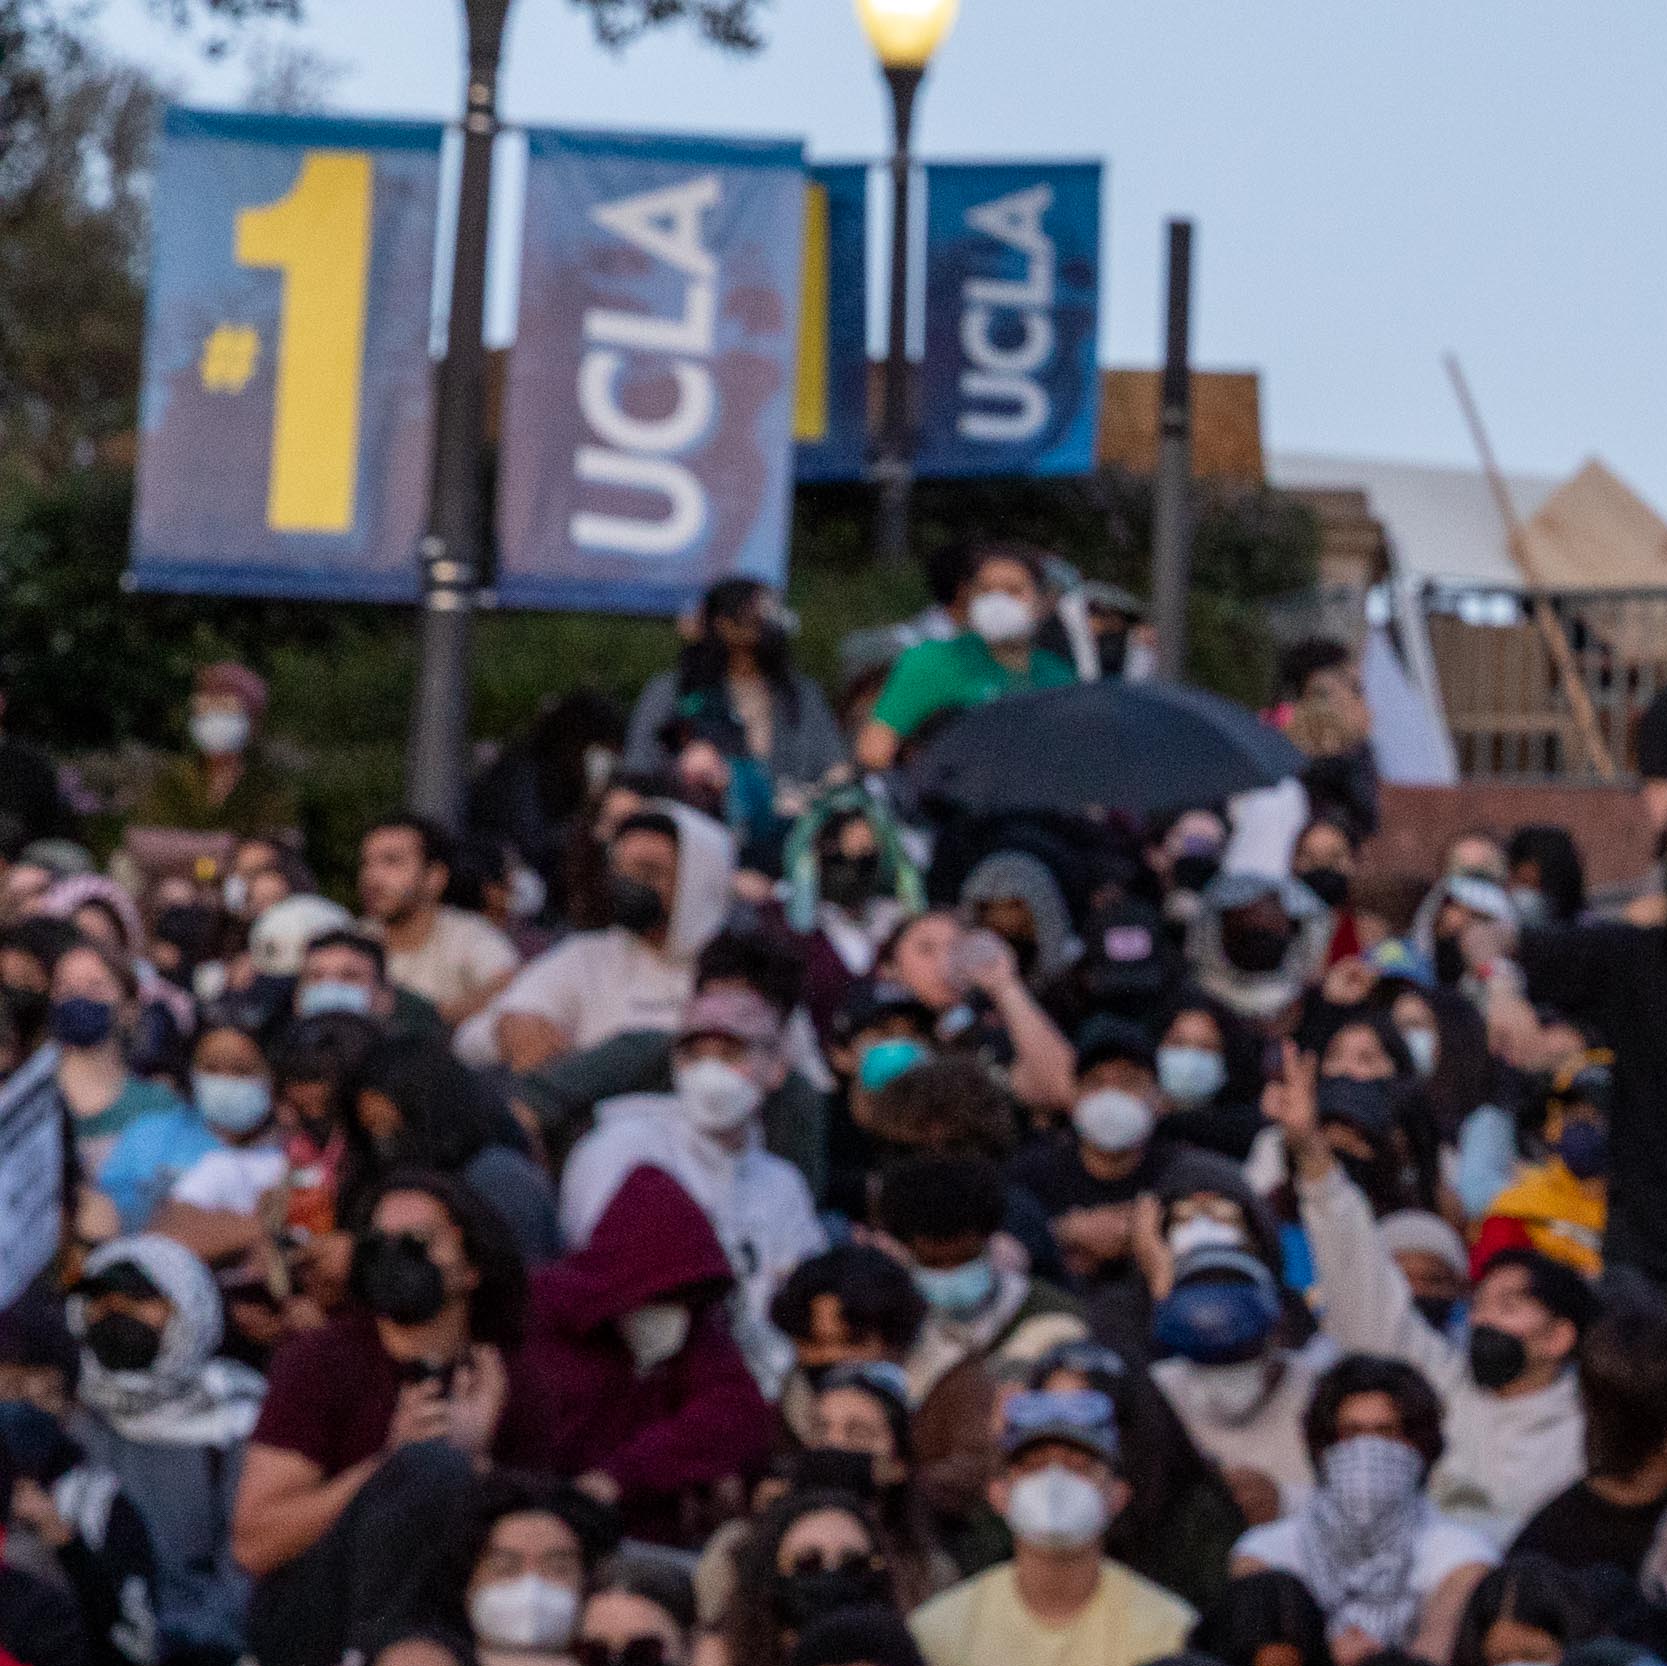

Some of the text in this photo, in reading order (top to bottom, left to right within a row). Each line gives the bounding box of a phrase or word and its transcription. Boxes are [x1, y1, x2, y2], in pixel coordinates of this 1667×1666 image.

[202, 152, 373, 532] #1
[570, 175, 718, 553] UCLA
[957, 183, 1055, 440] UCLA
